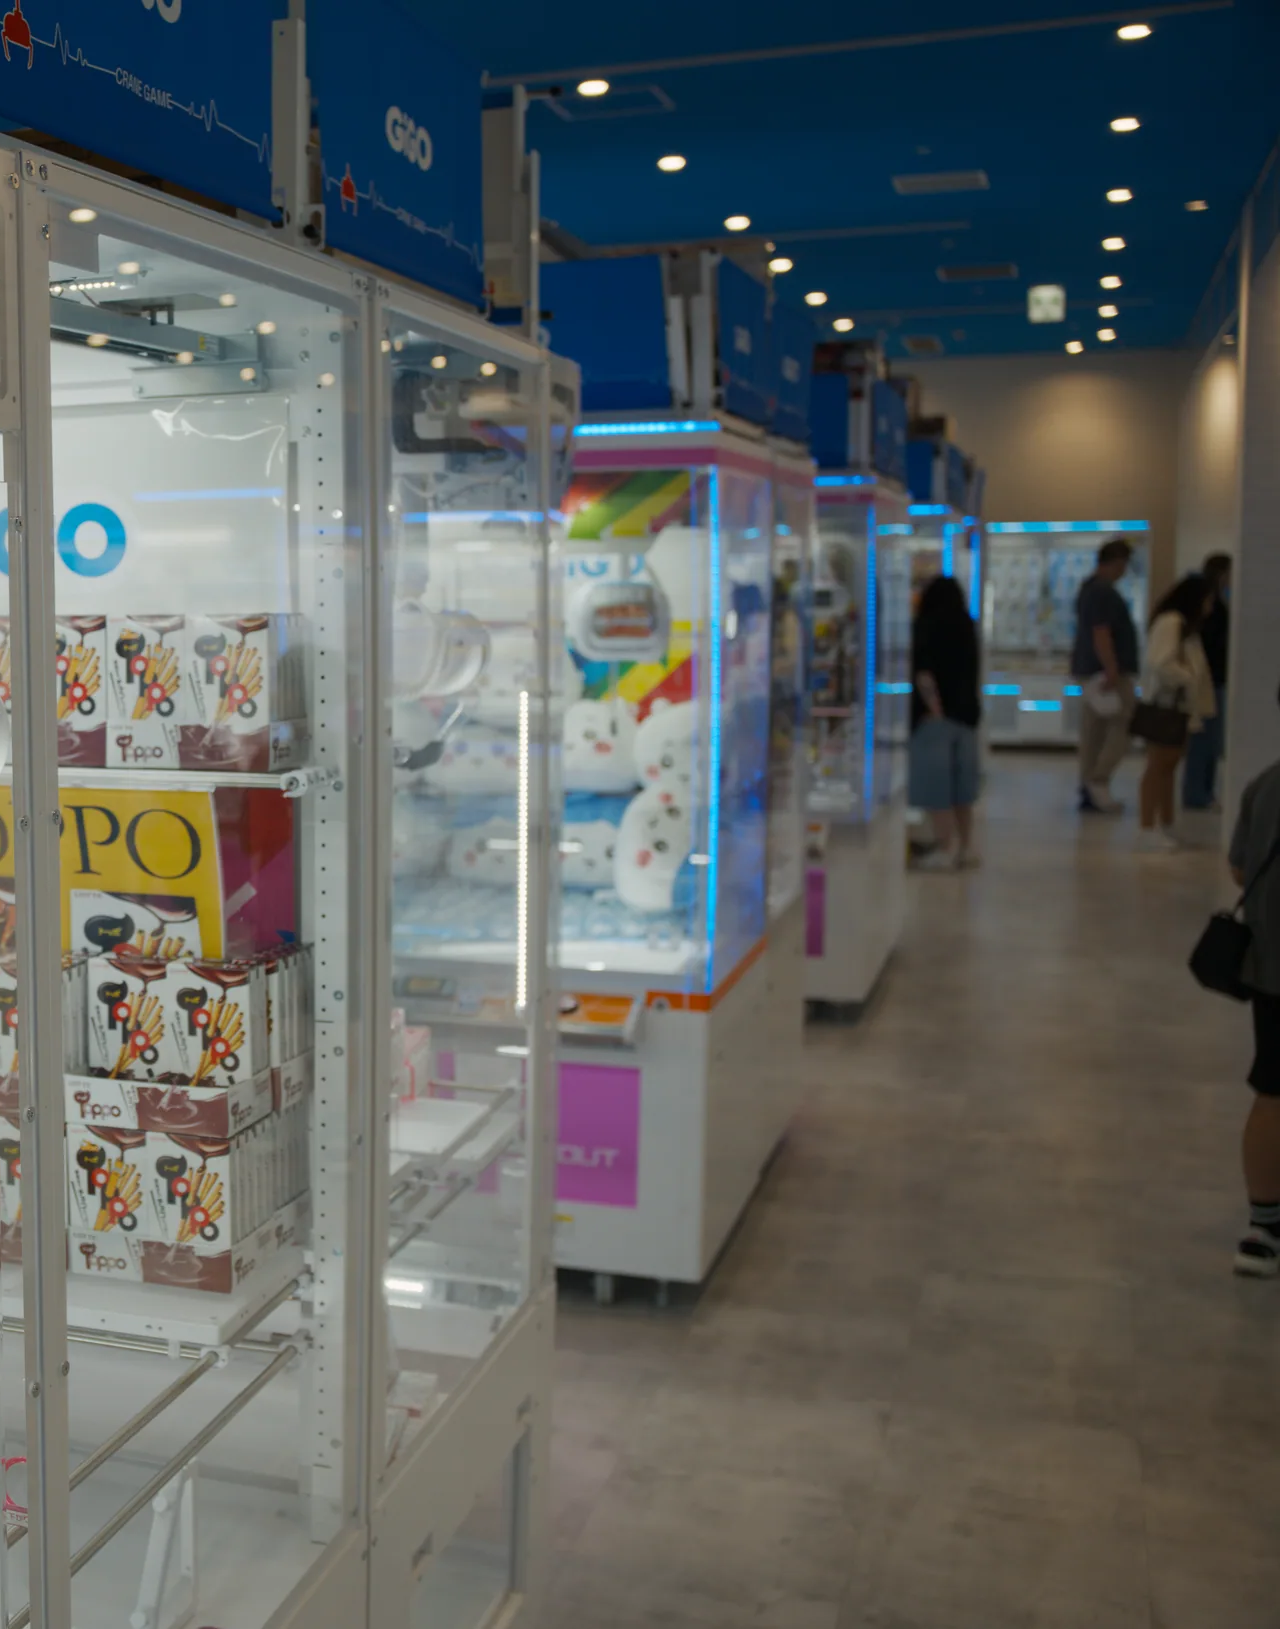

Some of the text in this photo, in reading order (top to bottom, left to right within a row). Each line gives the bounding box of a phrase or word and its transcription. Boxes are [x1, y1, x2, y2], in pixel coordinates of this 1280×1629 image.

[115, 67, 173, 109] CRANE GAME
[385, 105, 433, 171] GiGO
